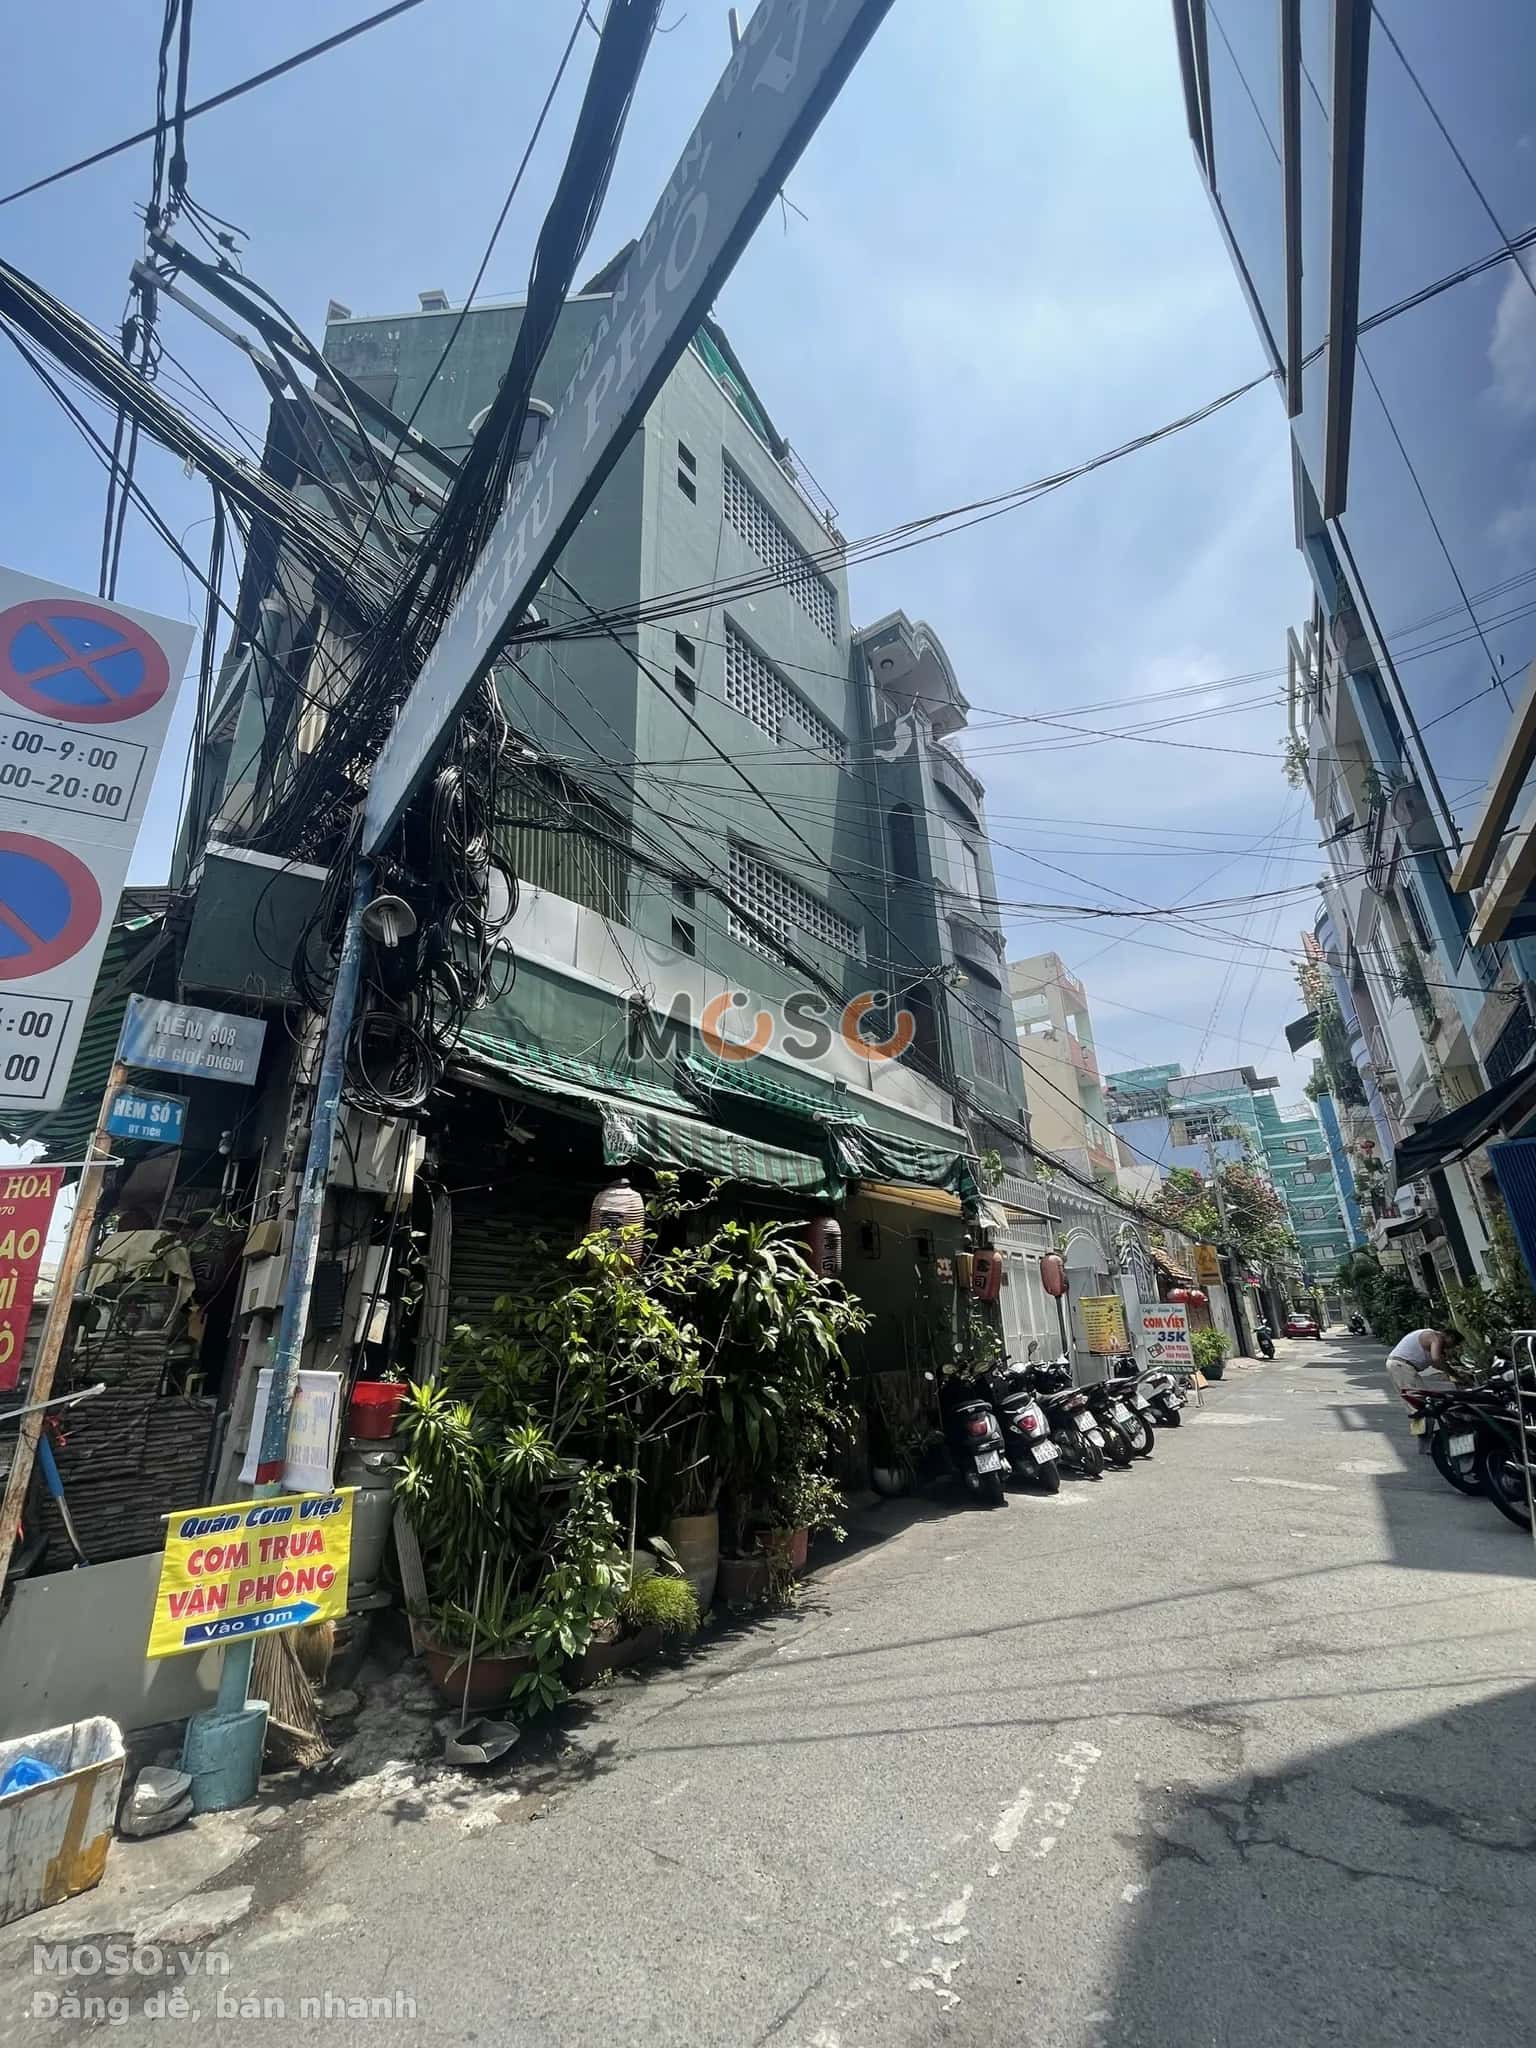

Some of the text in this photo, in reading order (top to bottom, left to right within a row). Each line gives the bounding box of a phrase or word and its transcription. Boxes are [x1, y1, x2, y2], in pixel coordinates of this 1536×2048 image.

[472, 457, 557, 650] KHU
[210, 1024, 237, 1047] 308
[175, 1108, 183, 1126] 1
[4, 1174, 52, 1198] HOA
[1157, 1331, 1186, 1342] 35K
[179, 1497, 344, 1539] Quán Cơm Việt
[187, 1530, 326, 1576] CƠM TRƯA
[168, 1564, 336, 1620] VĂN PHÒNG
[204, 1610, 293, 1637] Vào 10m
